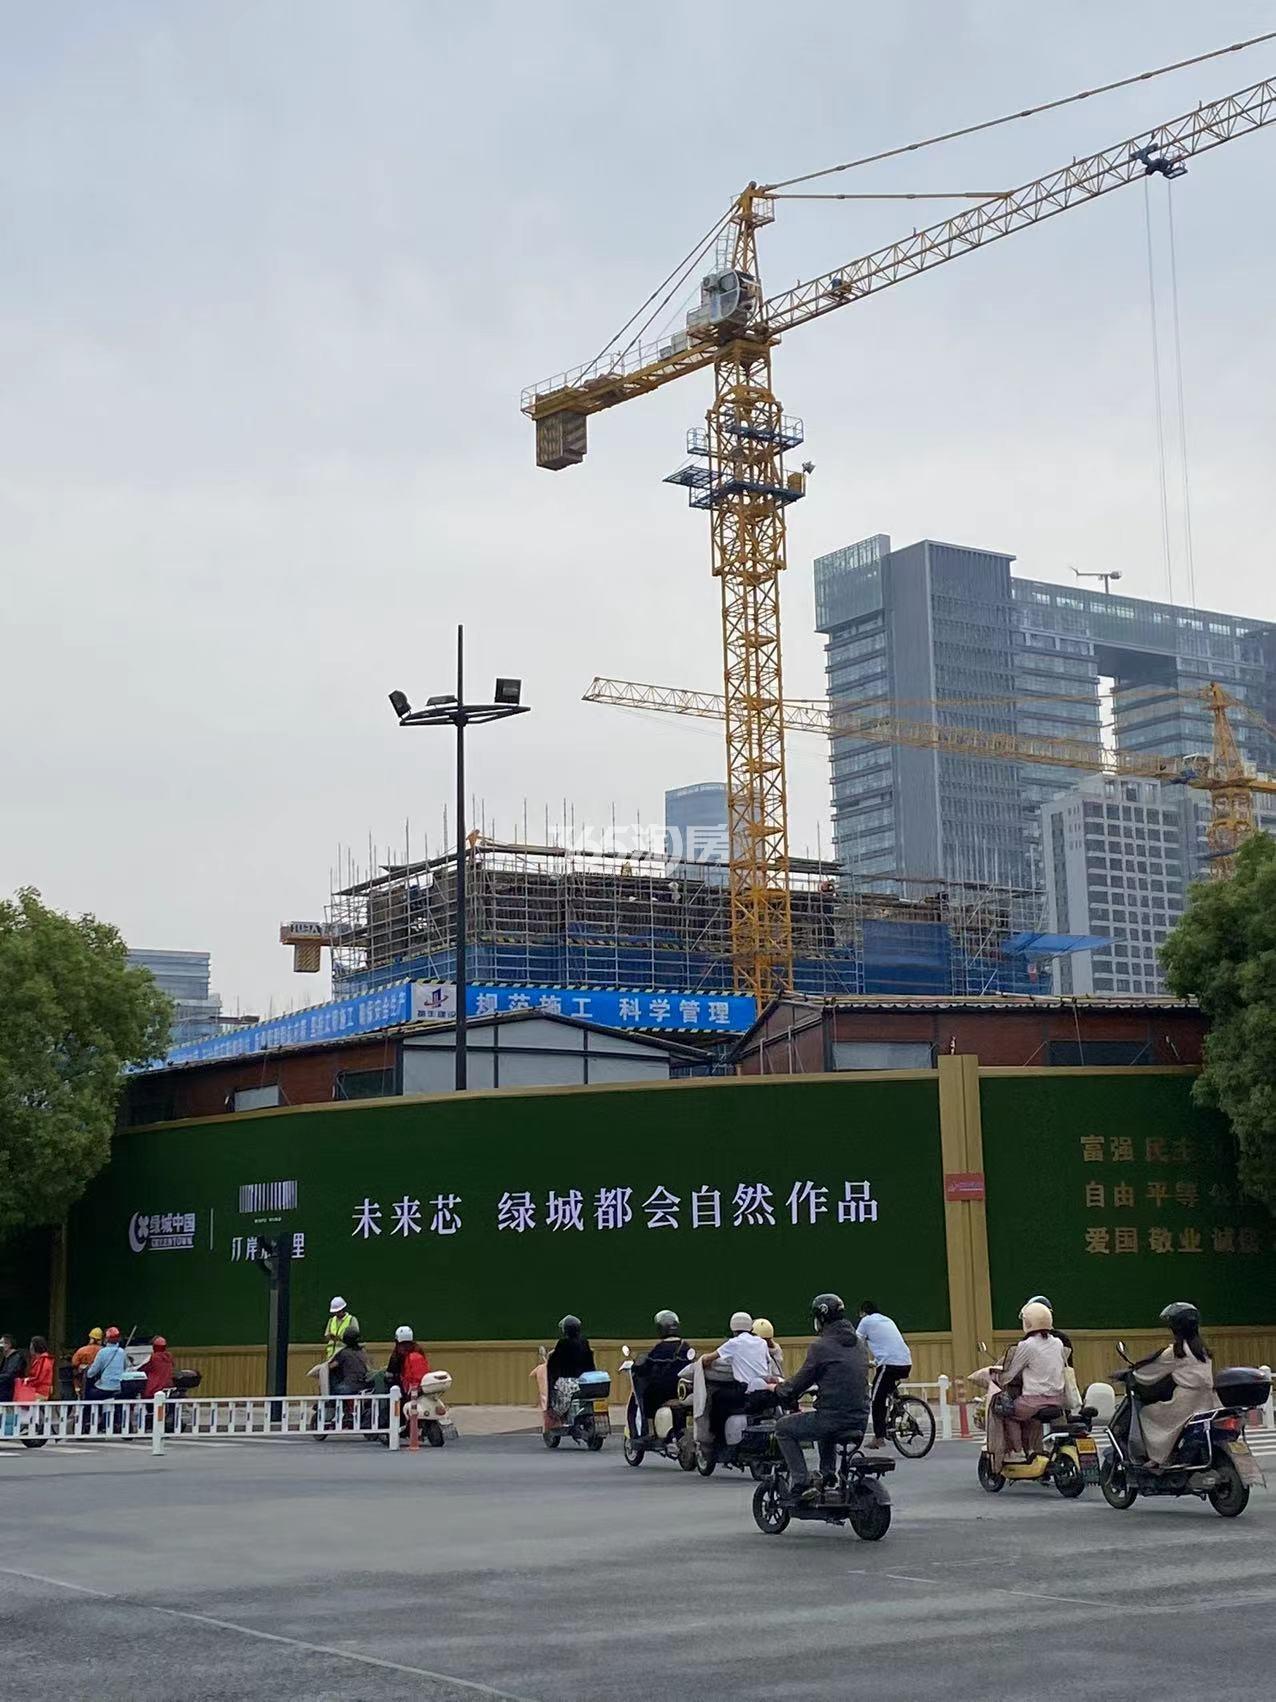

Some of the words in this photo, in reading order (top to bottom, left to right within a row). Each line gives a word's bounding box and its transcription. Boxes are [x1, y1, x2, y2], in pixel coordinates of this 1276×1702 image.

[476, 992, 593, 1019] 规范施工
[619, 997, 731, 1025] 科学管理
[1080, 1134, 1134, 1162] 富强
[1085, 1180, 1135, 1208] 自由
[149, 1212, 196, 1234] 绿城中国
[352, 1194, 461, 1238] 未来芯
[498, 1180, 877, 1232] 绿城都会自然作品
[1084, 1226, 1139, 1255] 爱国
[1148, 1226, 1203, 1254] 敬业
